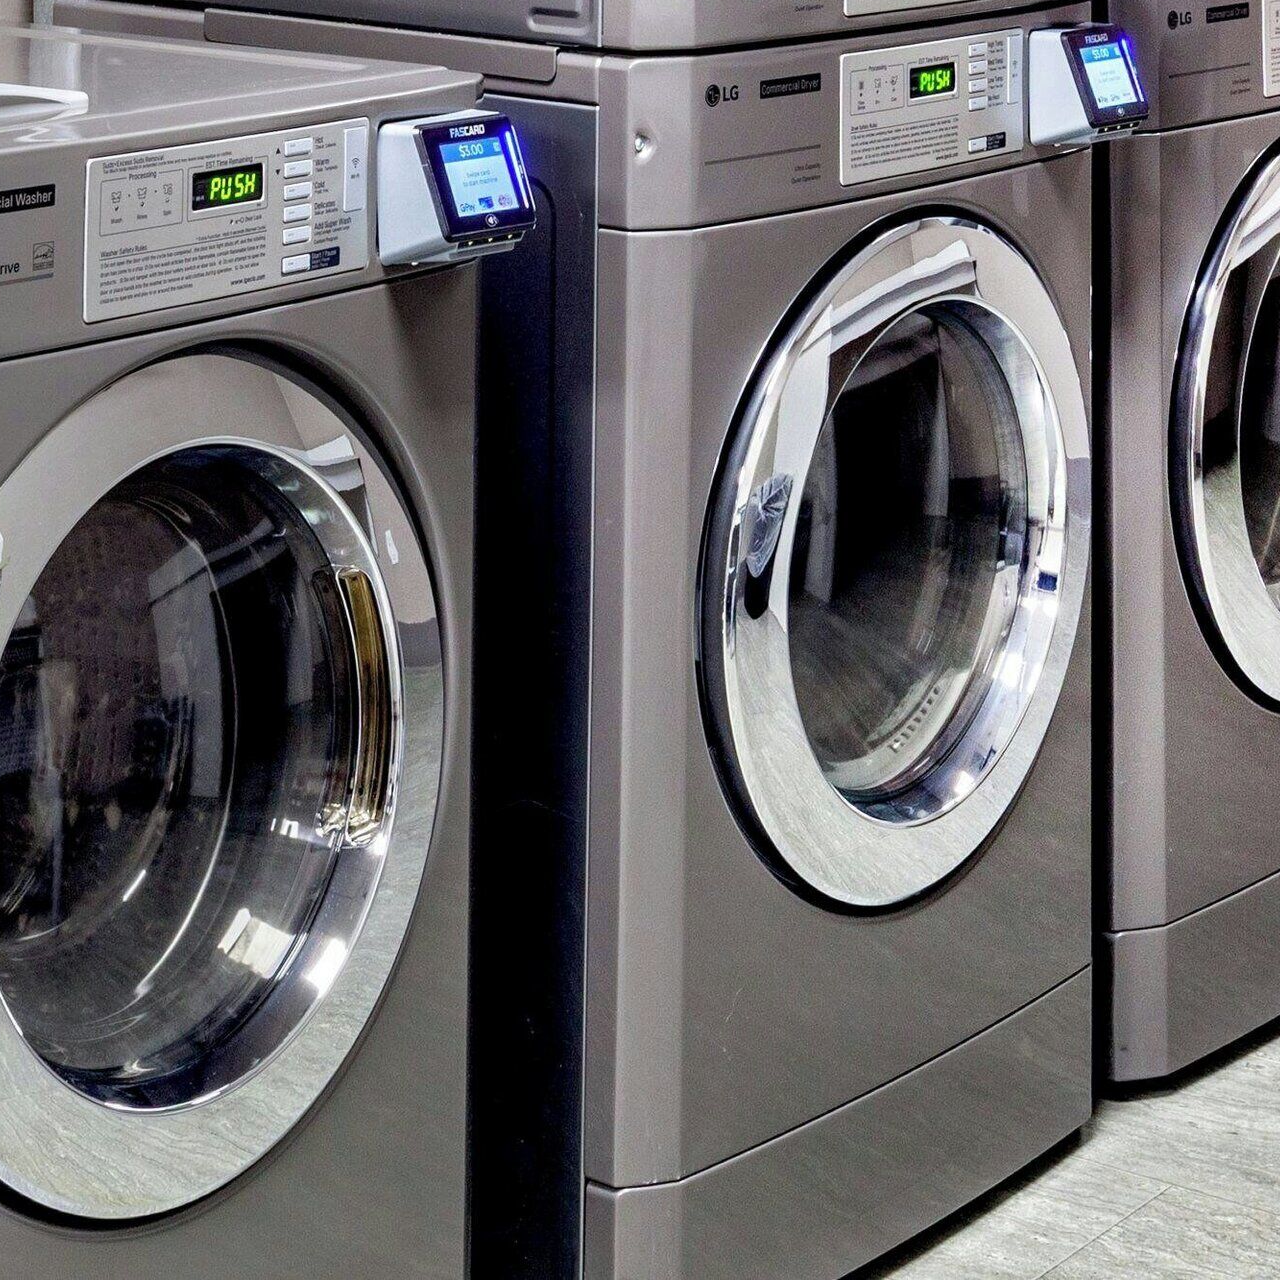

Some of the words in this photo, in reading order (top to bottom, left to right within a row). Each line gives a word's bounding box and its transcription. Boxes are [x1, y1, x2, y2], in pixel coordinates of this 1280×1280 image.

[1180, 12, 1191, 25] LG
[762, 81, 800, 95] Commercial
[801, 79, 819, 90] Dryer
[920, 70, 950, 92] PUSH
[723, 85, 739, 101] LG
[449, 124, 485, 138] FASCARD
[459, 144, 483, 158] $3.00
[129, 171, 157, 180] Processing
[210, 173, 256, 200] PUSH
[15, 190, 53, 207] Washer
